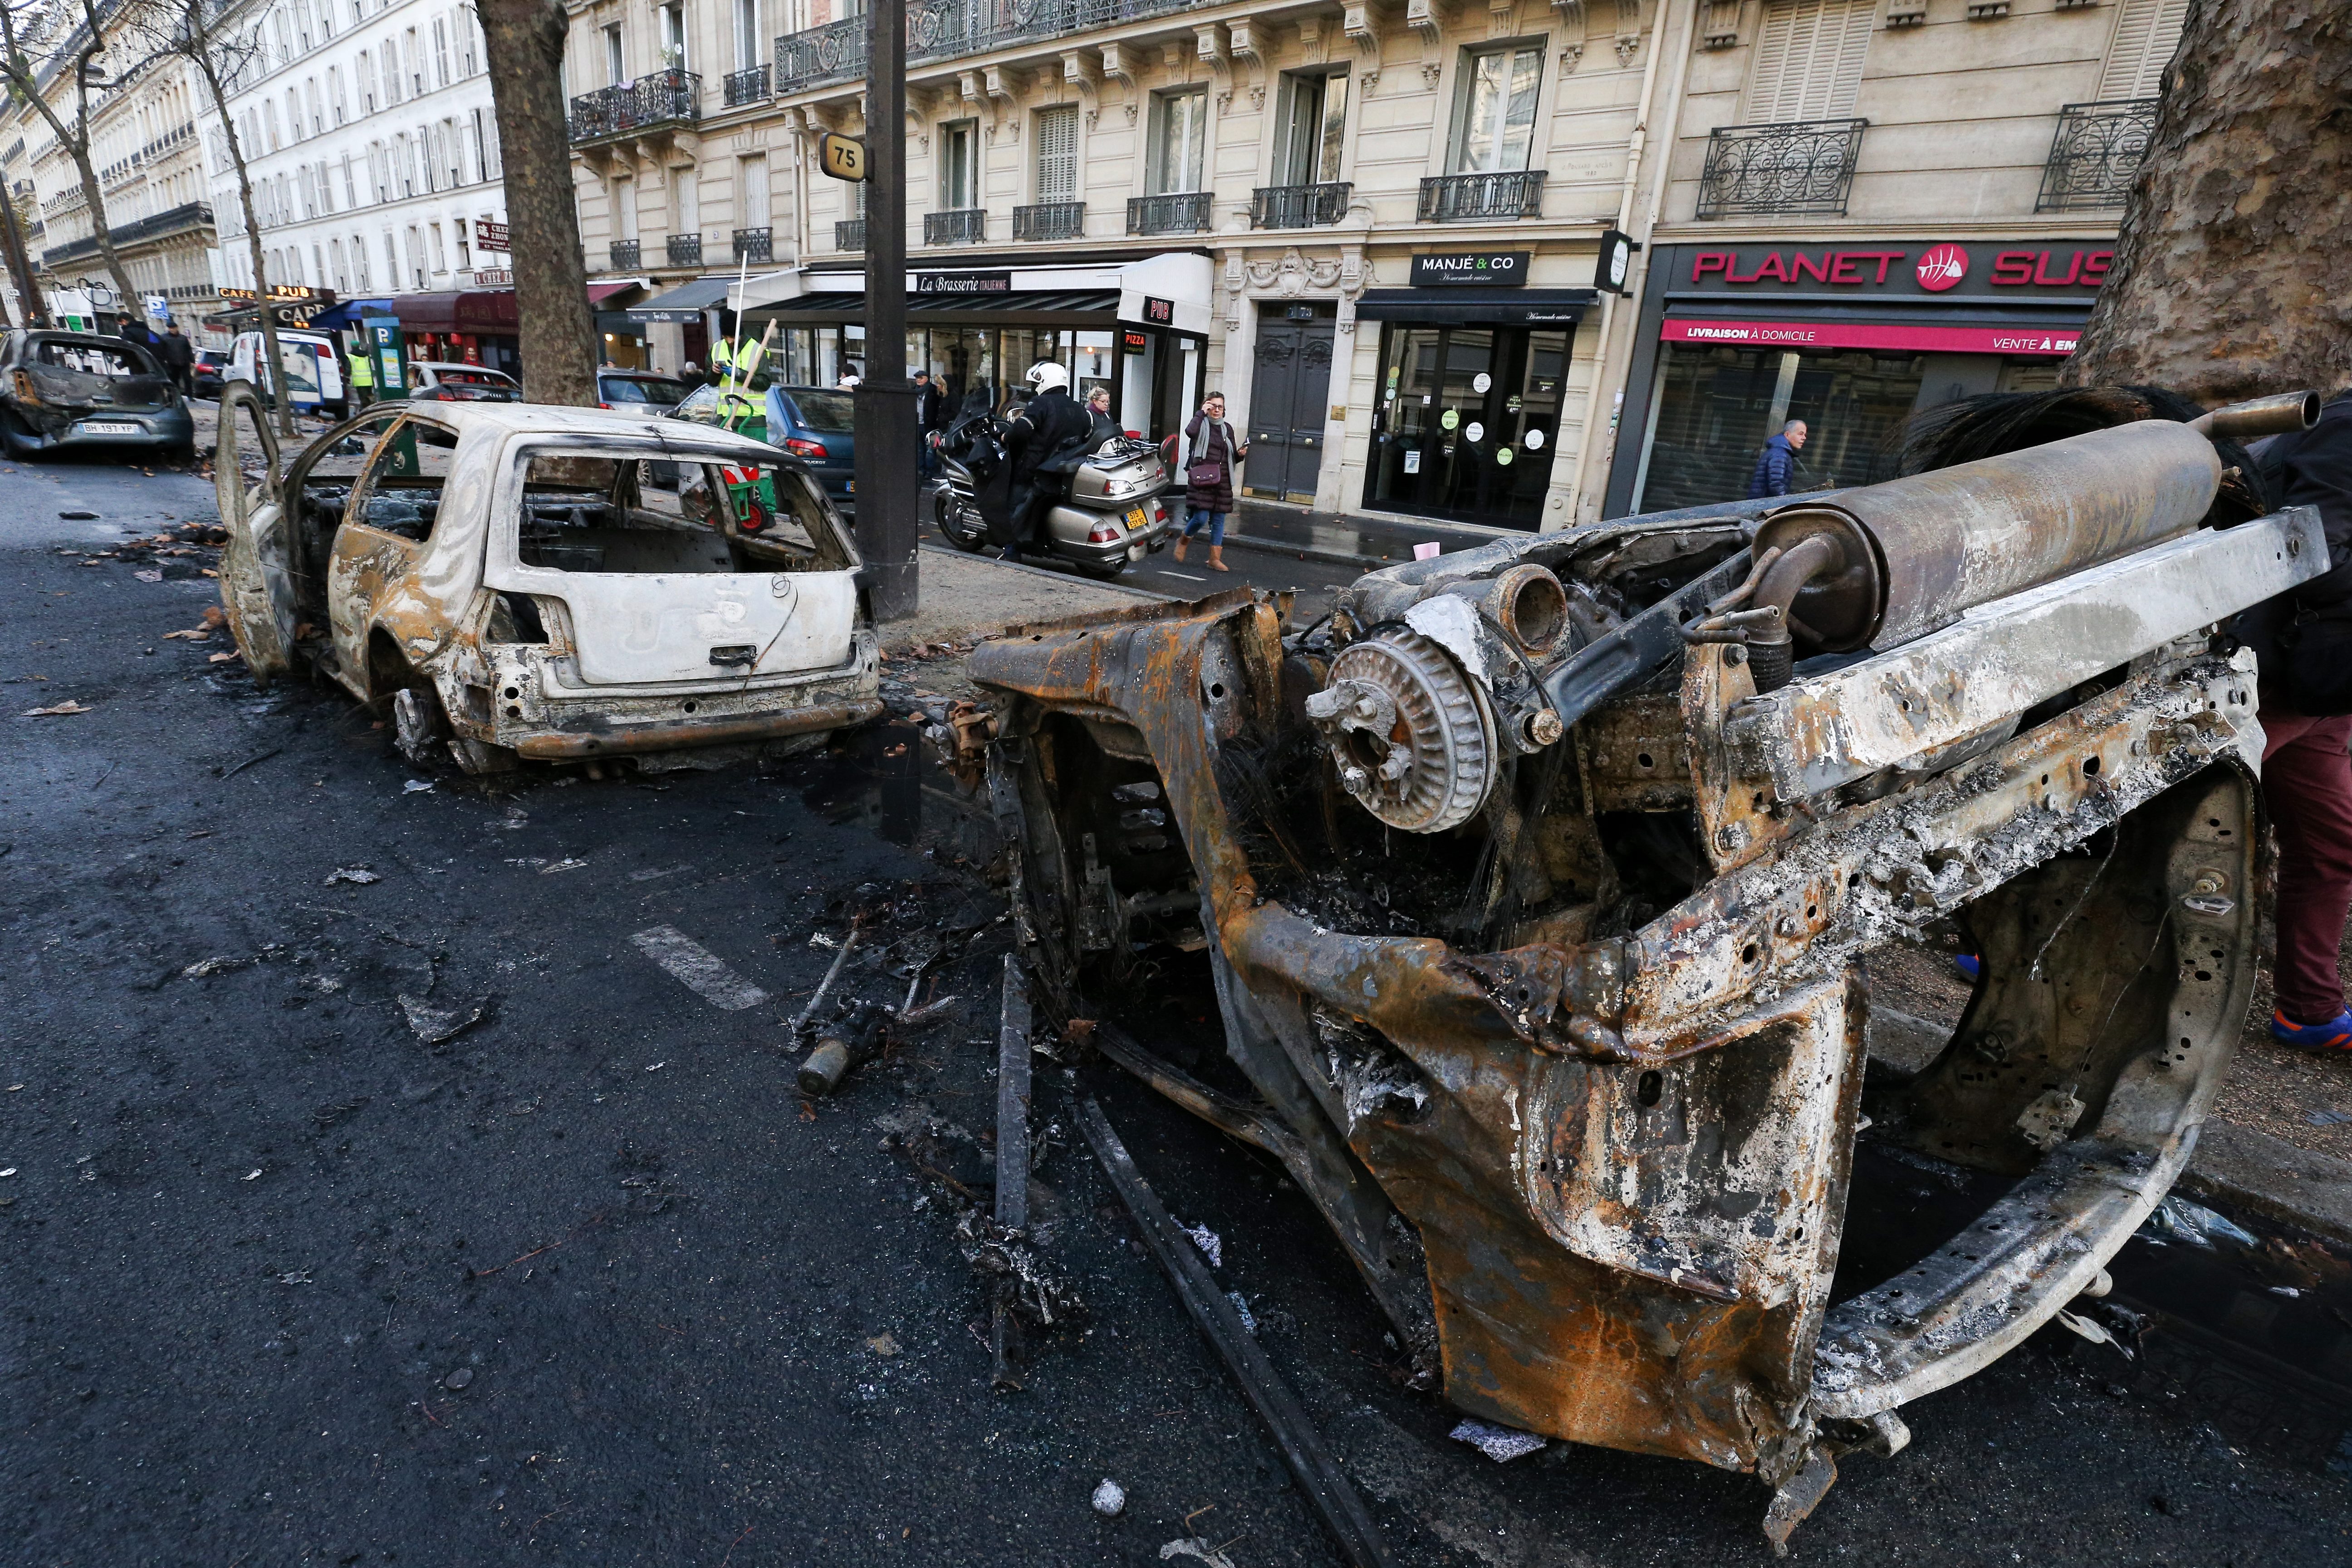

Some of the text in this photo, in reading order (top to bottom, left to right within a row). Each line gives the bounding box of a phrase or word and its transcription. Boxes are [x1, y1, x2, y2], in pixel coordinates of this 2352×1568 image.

[834, 146, 855, 168] 75
[491, 224, 509, 233] CHEZ
[1422, 255, 1514, 270] MANJÉ & CO
[1692, 252, 1905, 283] PLANET
[483, 272, 501, 284] CHEZ
[1440, 272, 1473, 281] Homemade
[920, 276, 1006, 291] La Brasserie ITALIENNE
[278, 286, 309, 298] PUB
[1151, 300, 1169, 319] PUB
[1300, 307, 1312, 317] 73
[1126, 334, 1144, 345] PIZZA
[1687, 327, 1815, 341] LIVRAISON À DOMICILE
[1993, 338, 2037, 350] VENTE
[2039, 337, 2051, 351] À
[1129, 511, 1139, 519] 575
[1129, 519, 1139, 528] ESY
